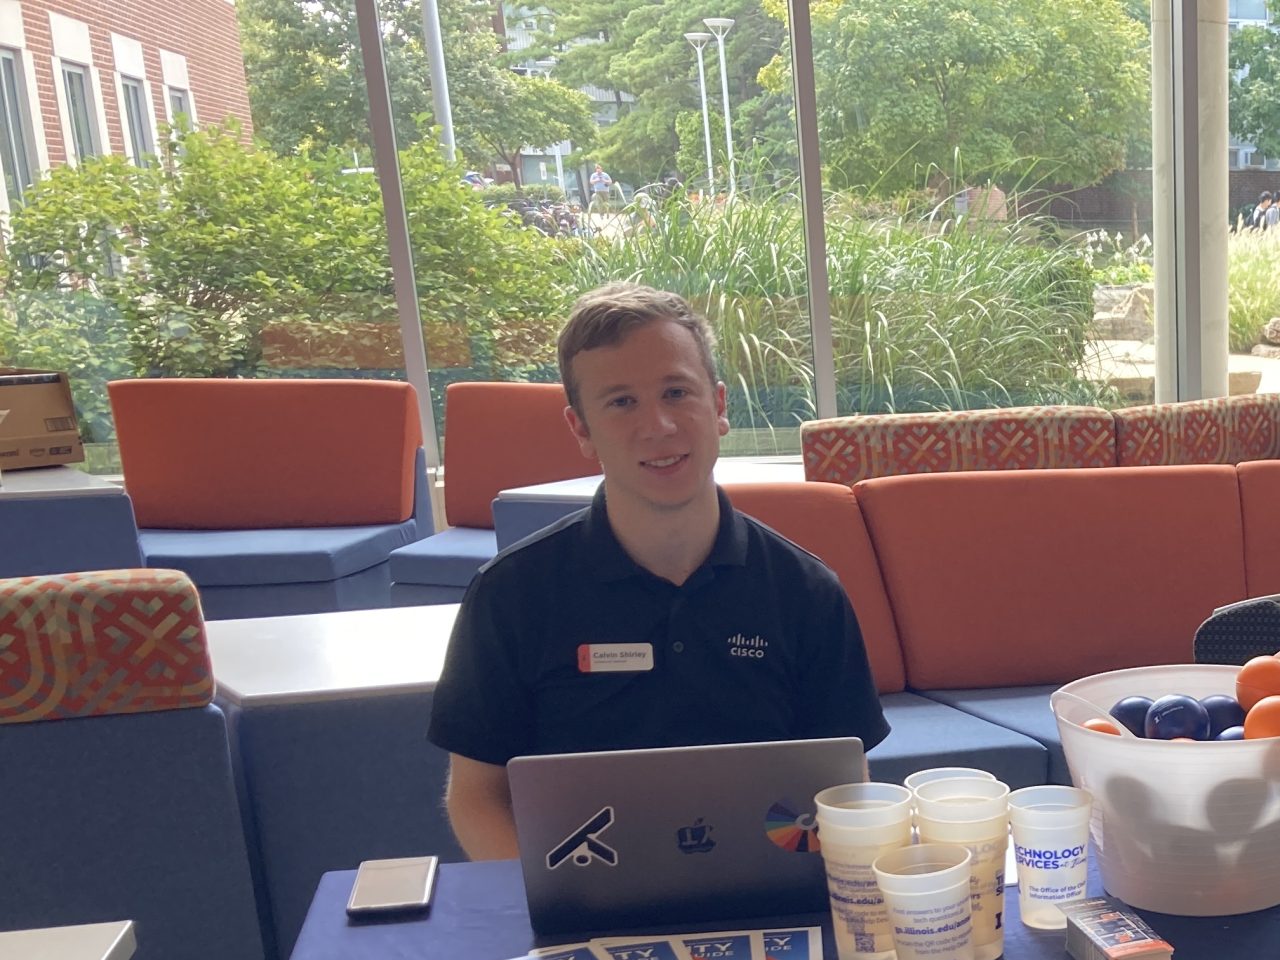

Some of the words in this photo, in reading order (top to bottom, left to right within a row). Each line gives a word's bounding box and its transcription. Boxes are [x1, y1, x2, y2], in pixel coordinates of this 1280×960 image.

[730, 647, 764, 658] CISCO
[1016, 844, 1085, 860] CHNOLOGY
[1016, 854, 1060, 870] RVICES
